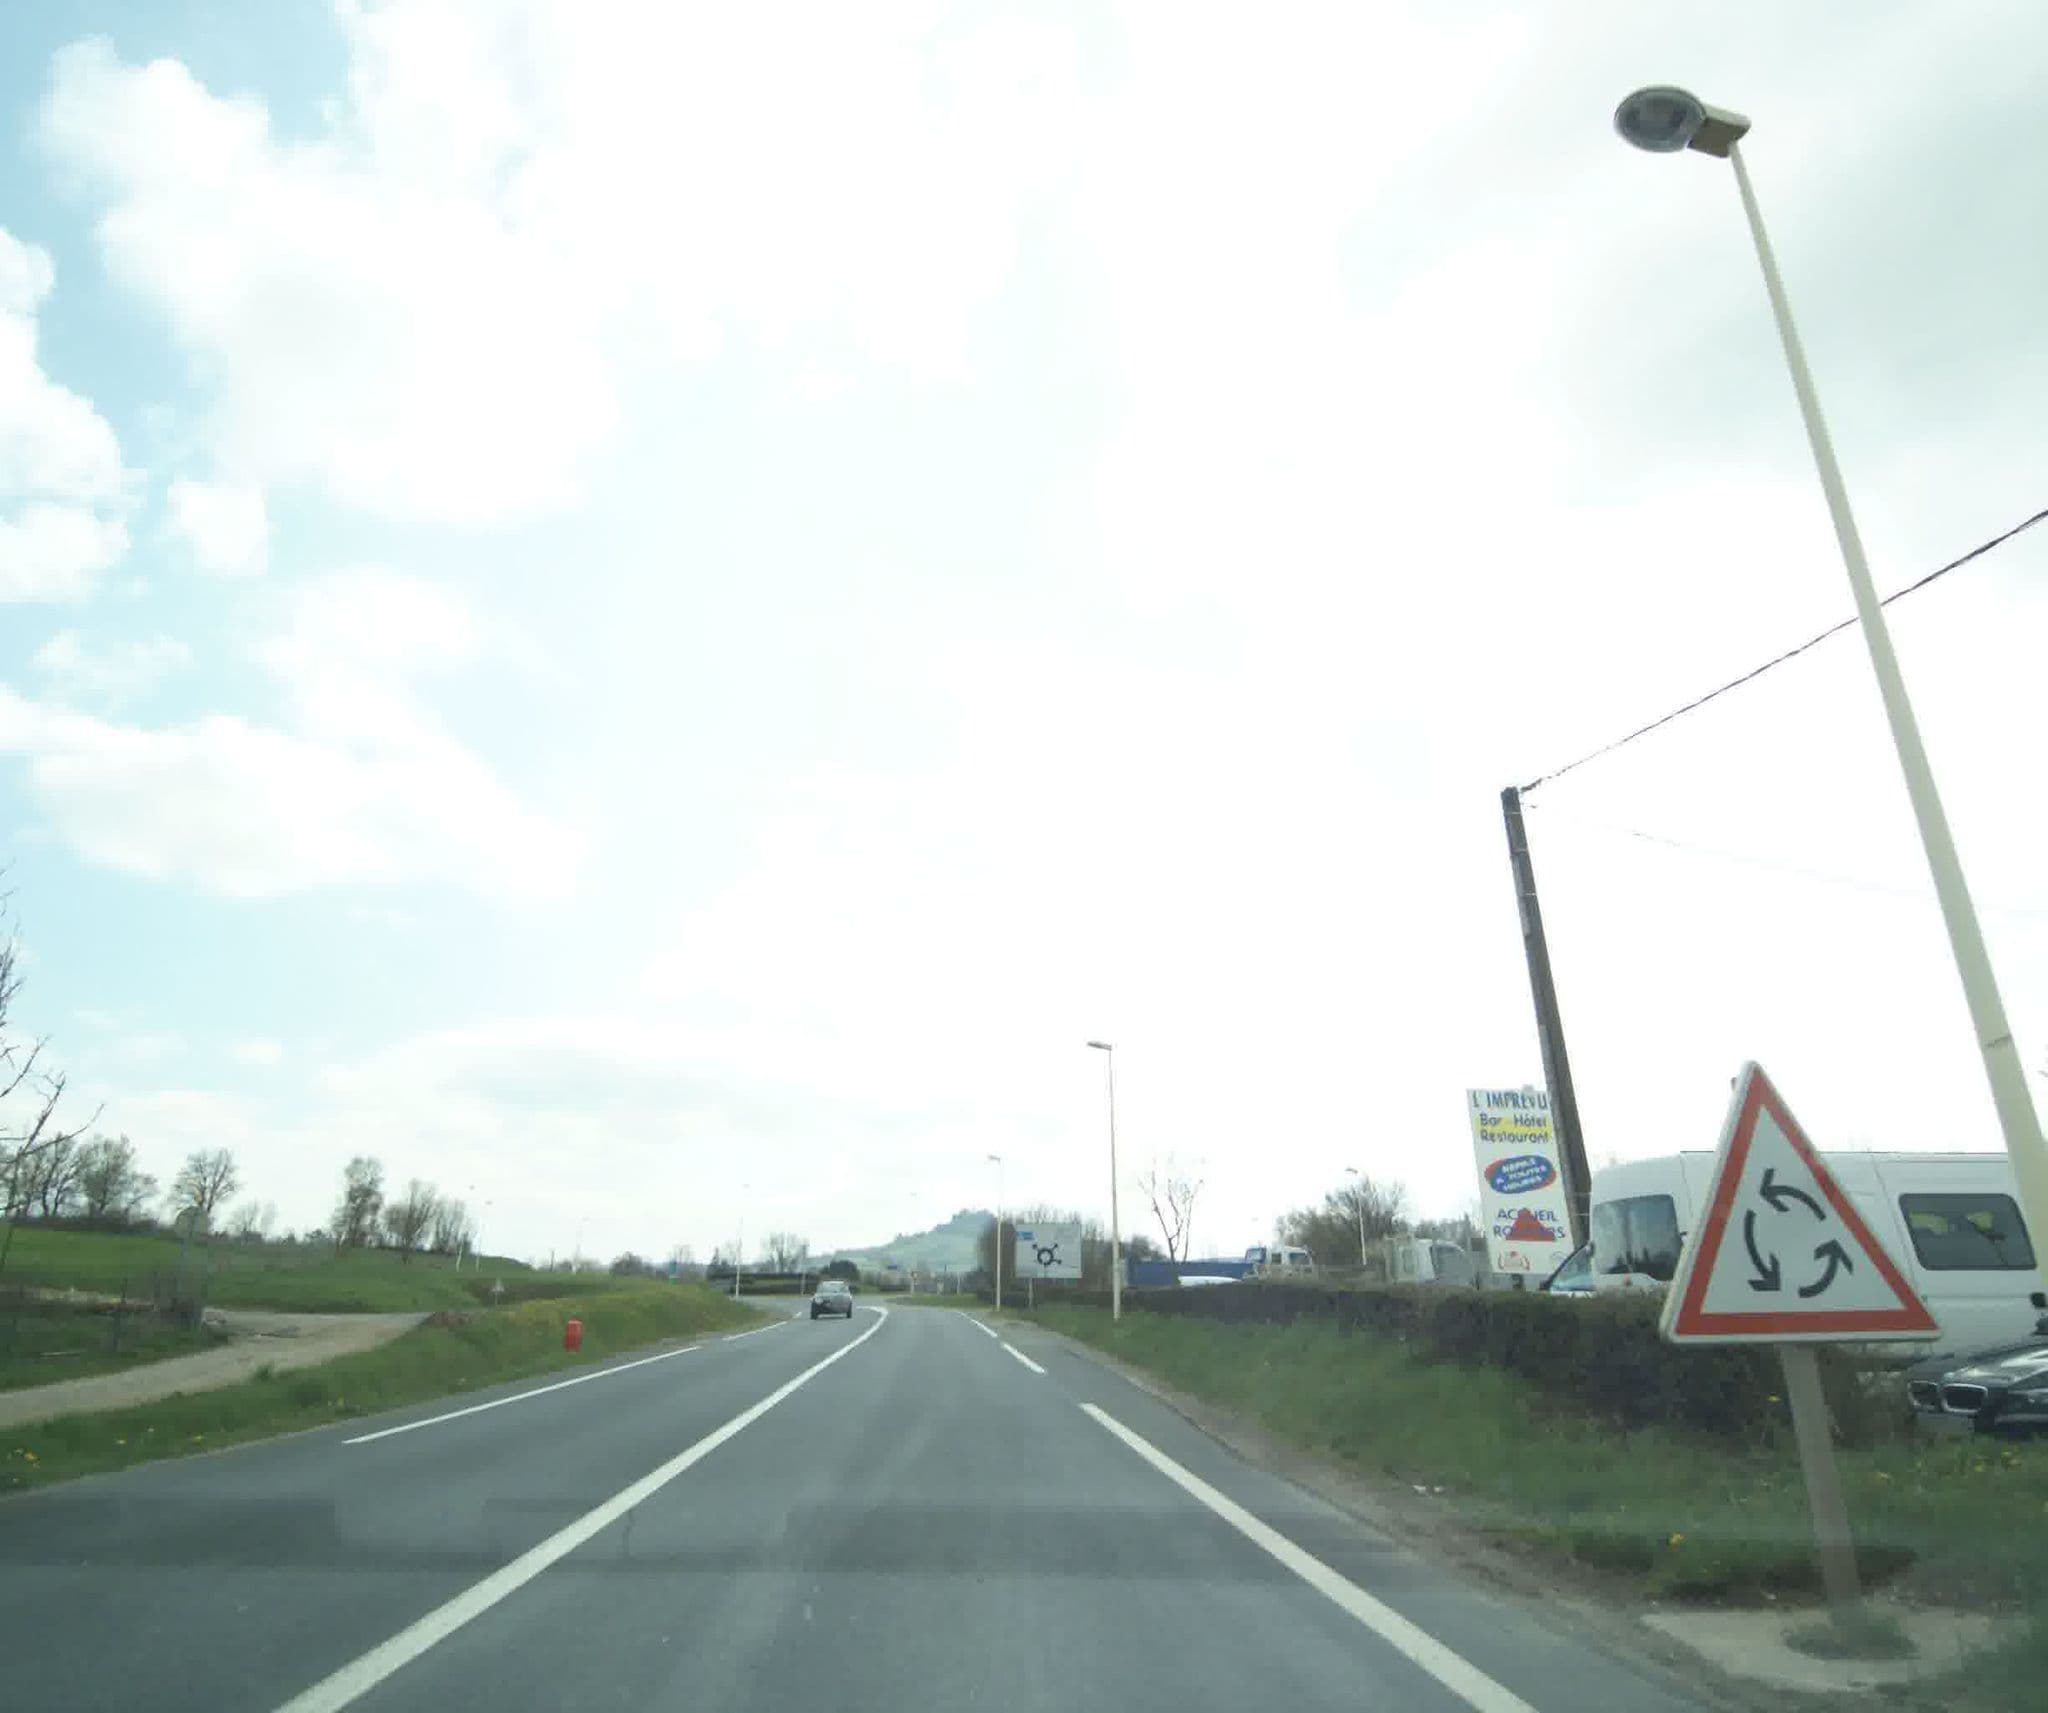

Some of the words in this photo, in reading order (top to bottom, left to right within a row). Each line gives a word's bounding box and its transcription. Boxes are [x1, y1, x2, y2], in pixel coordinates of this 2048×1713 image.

[1480, 1113, 1502, 1126] Bar
[1480, 1129, 1549, 1143] Restaurant
[1493, 1224, 1566, 1239] RORS
